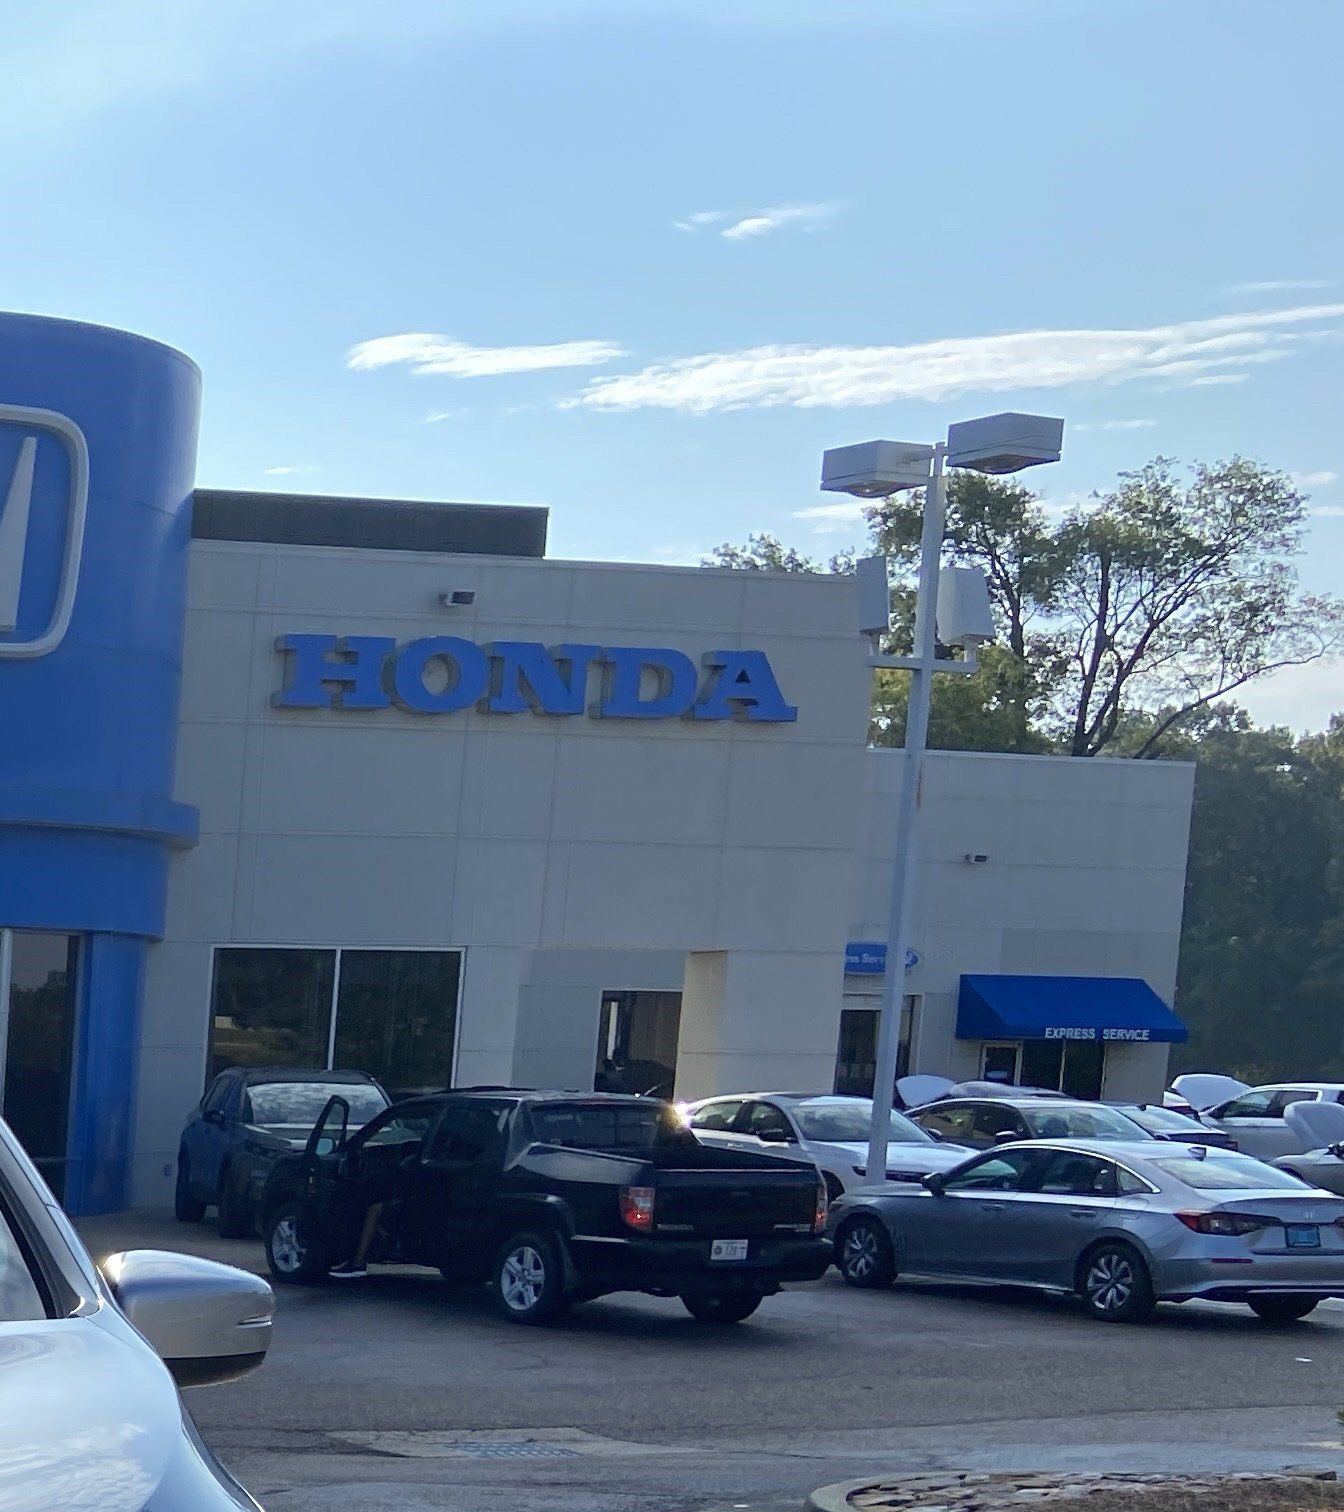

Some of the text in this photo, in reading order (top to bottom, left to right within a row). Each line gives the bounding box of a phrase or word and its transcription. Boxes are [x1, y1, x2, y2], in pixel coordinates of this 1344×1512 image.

[274, 632, 798, 723] HONDA
[1045, 1027, 1150, 1040] EXPRESS SERVICE
